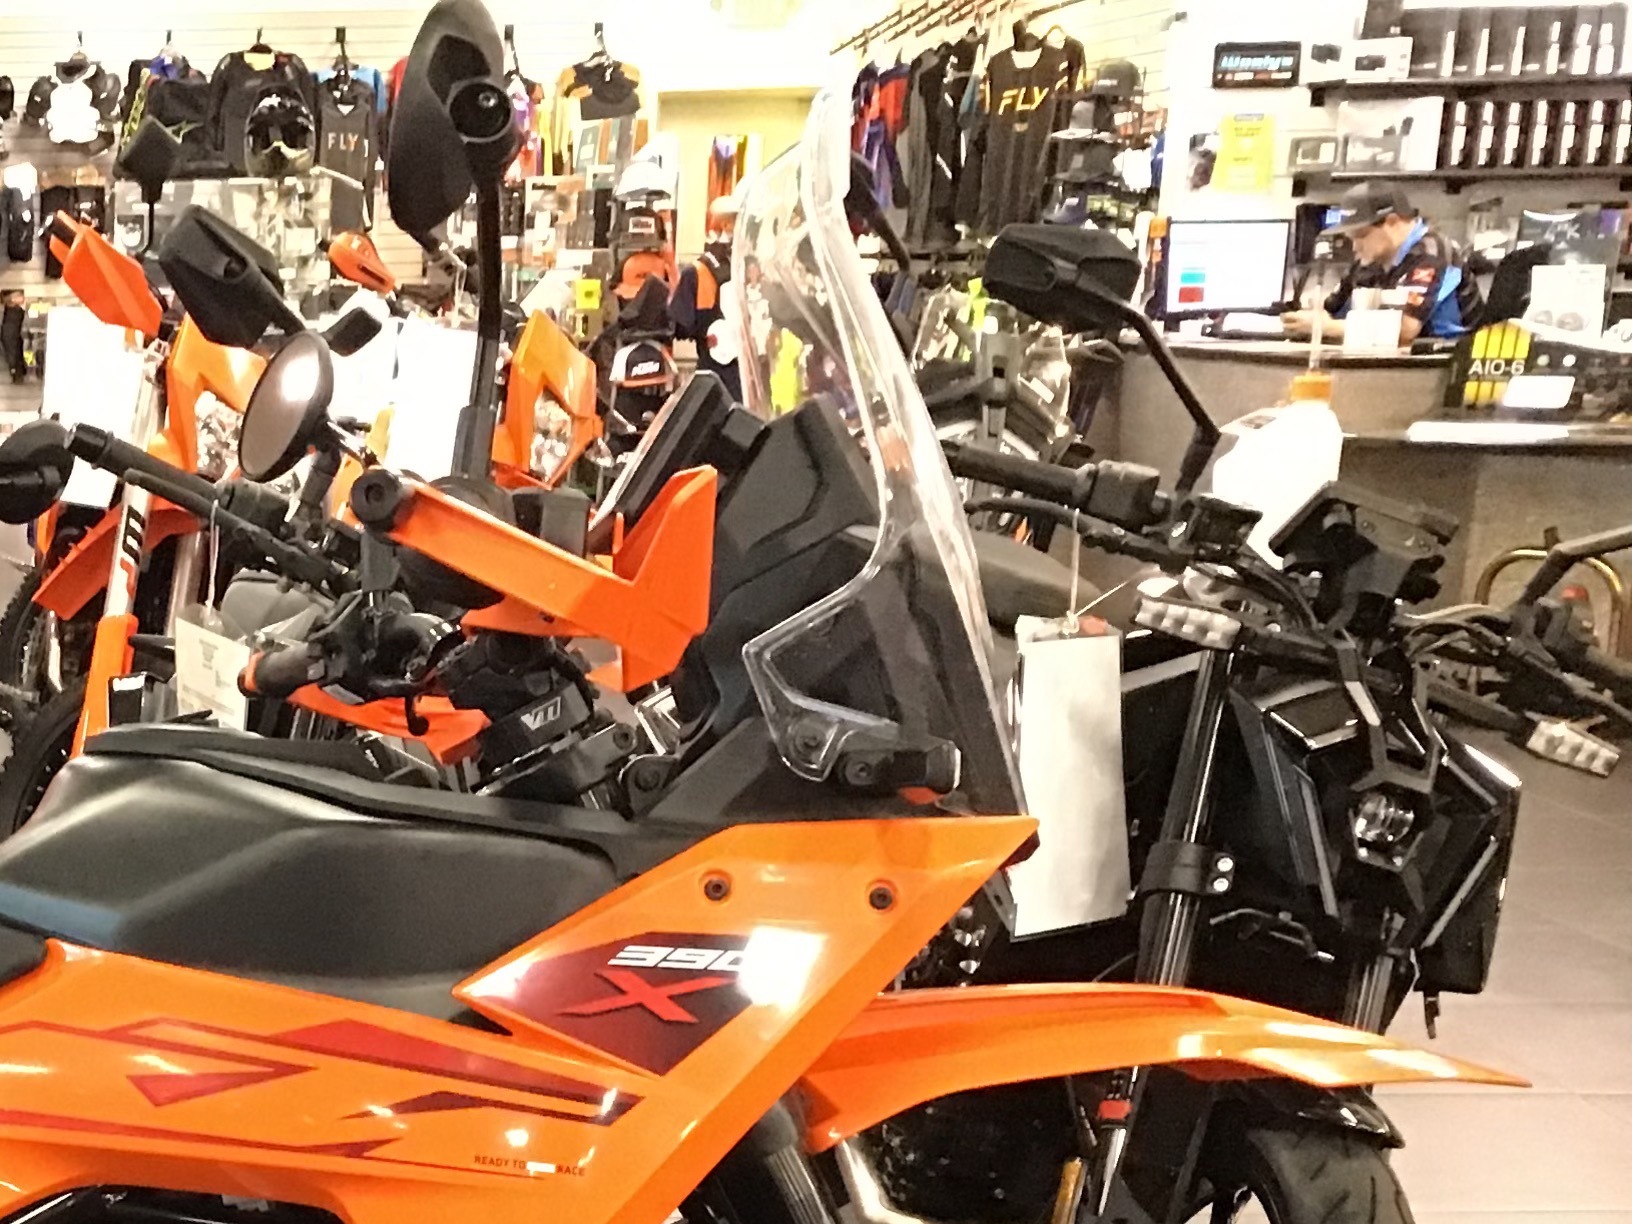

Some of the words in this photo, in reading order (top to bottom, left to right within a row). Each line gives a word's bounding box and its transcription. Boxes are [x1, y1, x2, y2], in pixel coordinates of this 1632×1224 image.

[998, 86, 1050, 116] FLY
[327, 131, 360, 153] FLY
[1468, 358, 1526, 375] AIO-6
[473, 1155, 509, 1168] READY
[512, 1159, 527, 1170] TO
[555, 1164, 586, 1177] RACE
